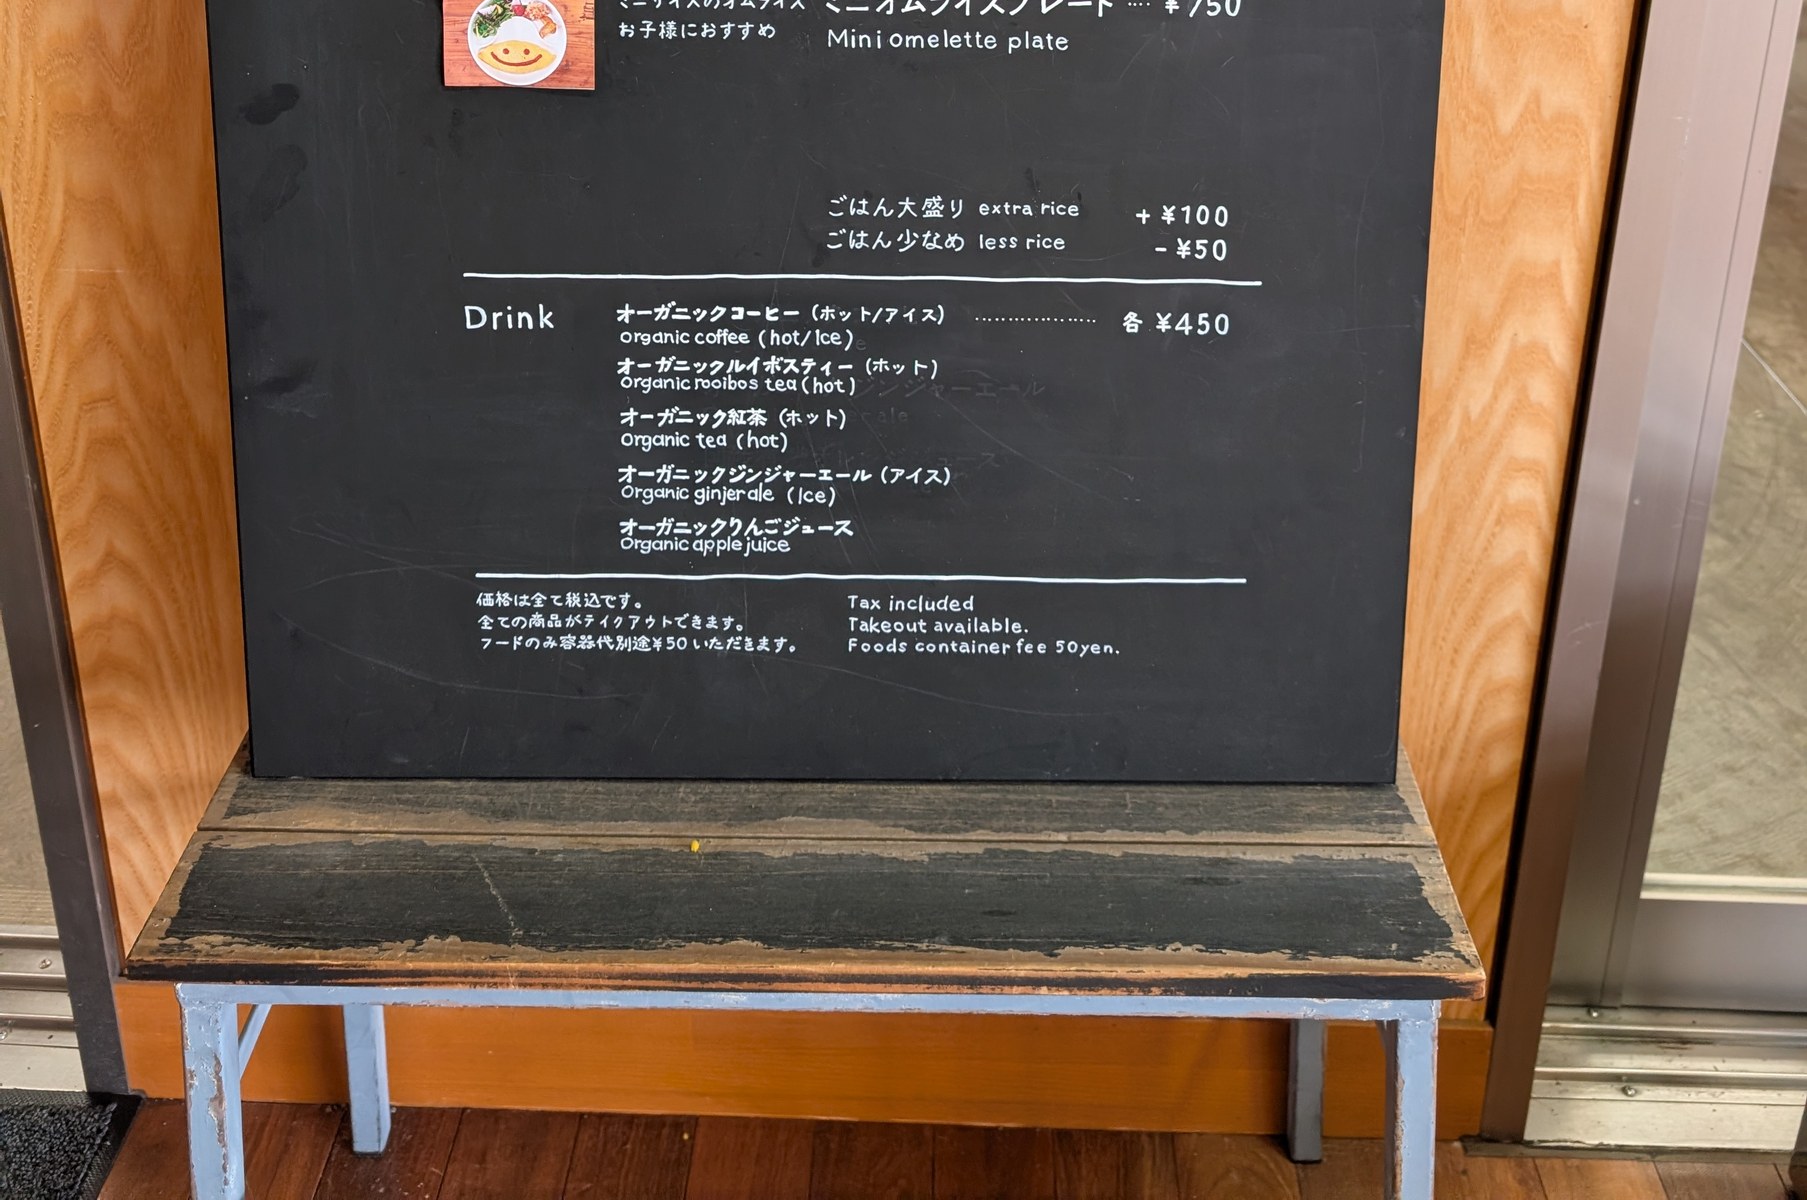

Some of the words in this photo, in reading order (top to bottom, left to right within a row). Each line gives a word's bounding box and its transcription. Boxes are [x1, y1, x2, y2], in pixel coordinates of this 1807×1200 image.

[618, 20, 776, 41] お子様におすすめ
[827, 28, 882, 50] Mini
[889, 28, 998, 50] omelette
[1008, 30, 1069, 55] plate
[828, 194, 963, 219] ごはん大盛り
[978, 201, 1034, 217] extra
[1040, 201, 1080, 217] rice
[826, 228, 965, 253] ごはん少なめ
[979, 233, 1019, 251] less
[1025, 233, 1066, 251] rice
[464, 303, 555, 331] Drink
[694, 328, 751, 346] coffee
[694, 374, 759, 391] rooibos
[694, 432, 728, 450] tea
[736, 429, 788, 454] (hot)
[619, 516, 854, 539] オーガニックりんごジュース
[692, 534, 743, 557] apple
[743, 536, 791, 558] juice
[475, 590, 642, 610] 価格は全て税込です。
[847, 594, 882, 611] Tax
[888, 594, 974, 613] included
[477, 611, 744, 632] 全ての商品がテイクアウトできます。
[848, 616, 927, 634] Takeout
[933, 616, 1029, 635] available.
[848, 637, 908, 654] Foods
[914, 639, 1011, 655] container
[1015, 637, 1047, 655] fee
[1055, 639, 1120, 658] 50yen.
